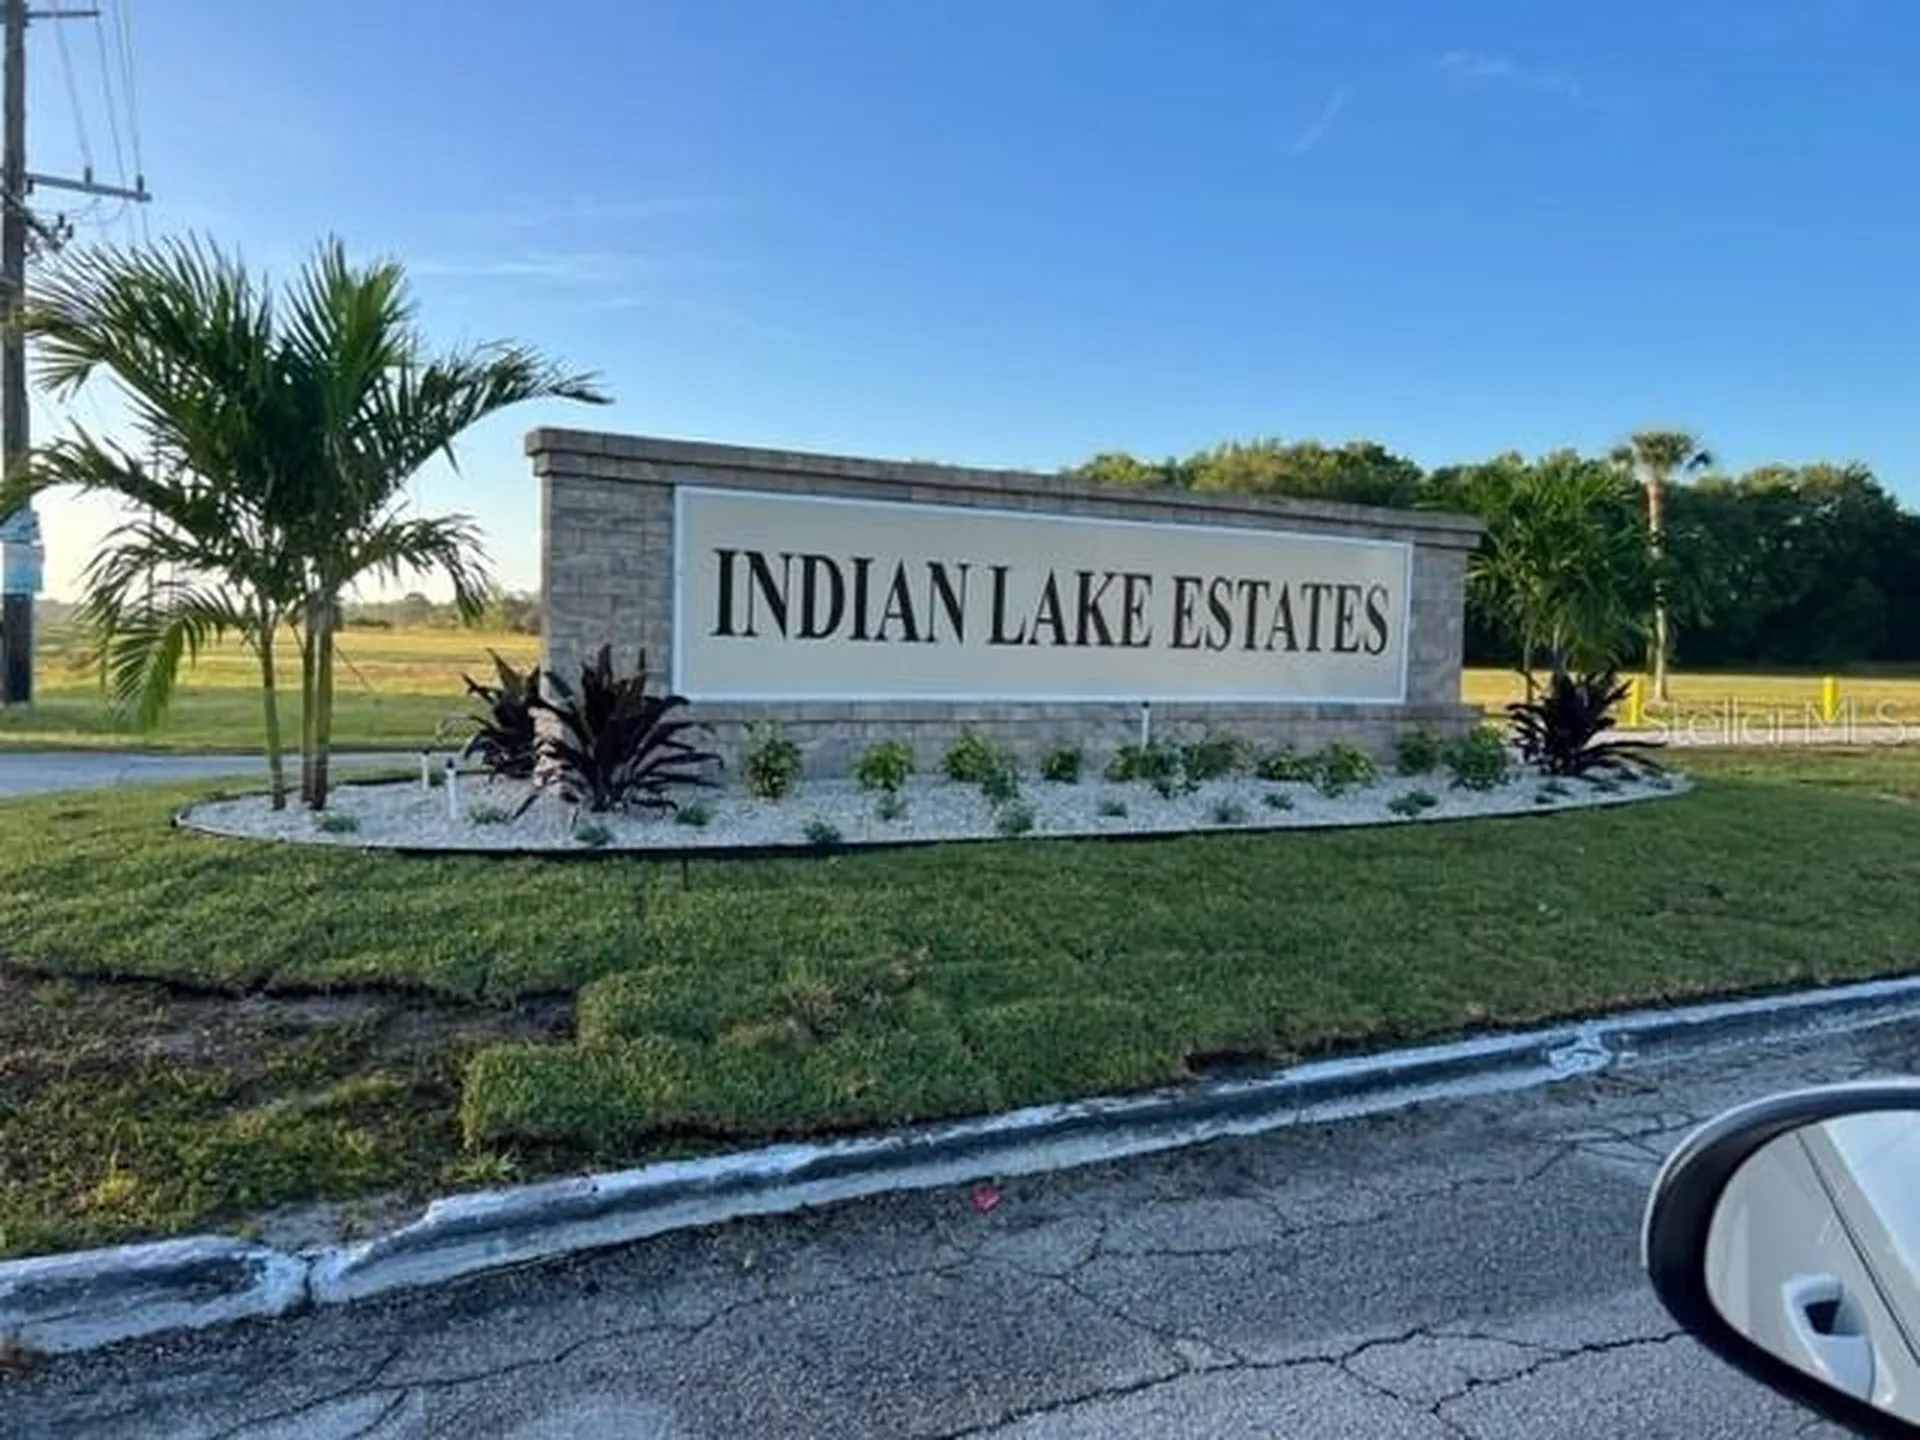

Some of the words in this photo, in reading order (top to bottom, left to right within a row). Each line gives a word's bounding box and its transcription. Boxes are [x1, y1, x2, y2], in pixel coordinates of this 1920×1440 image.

[710, 547, 972, 645] INDIAN
[986, 565, 1152, 646] LAKE
[1168, 575, 1390, 655] ESTATES
